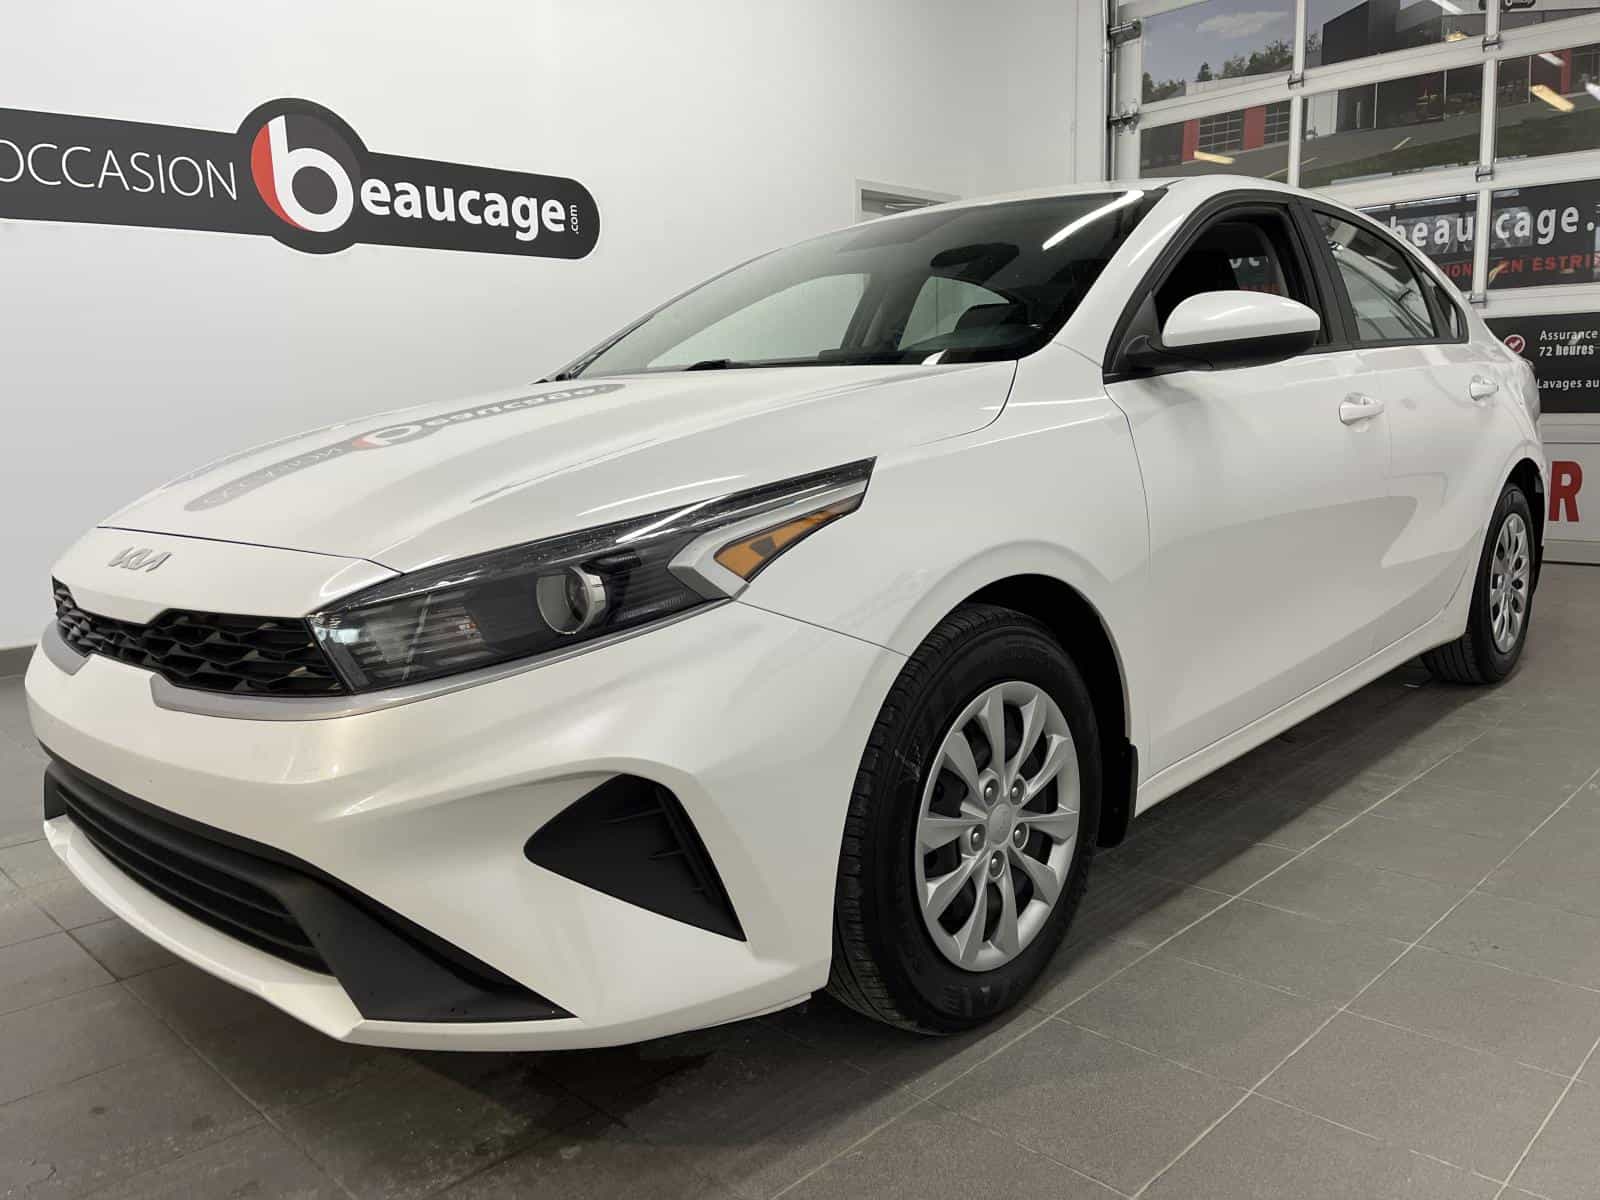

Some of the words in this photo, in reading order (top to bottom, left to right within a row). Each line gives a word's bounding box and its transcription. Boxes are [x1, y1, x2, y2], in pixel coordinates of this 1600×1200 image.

[1540, 330, 1599, 341] Assurance
[1539, 346, 1553, 357] 72
[1555, 344, 1594, 356] heures
[1537, 378, 1582, 391] Lavages
